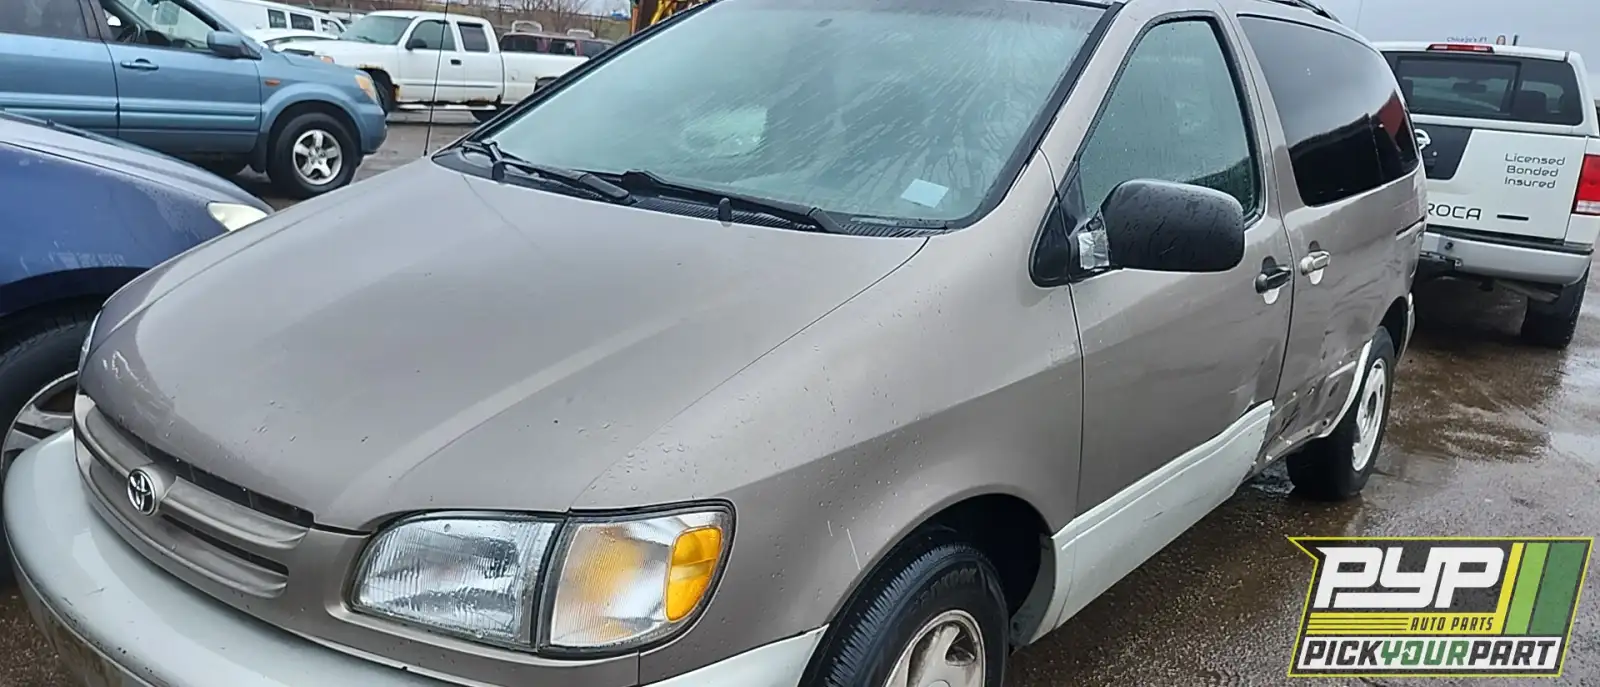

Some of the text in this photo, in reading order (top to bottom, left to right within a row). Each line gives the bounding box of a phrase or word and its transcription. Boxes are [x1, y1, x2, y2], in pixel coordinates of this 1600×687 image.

[1504, 152, 1566, 166] Licensed
[1506, 165, 1559, 177] Bonded
[1504, 176, 1556, 189] Insured
